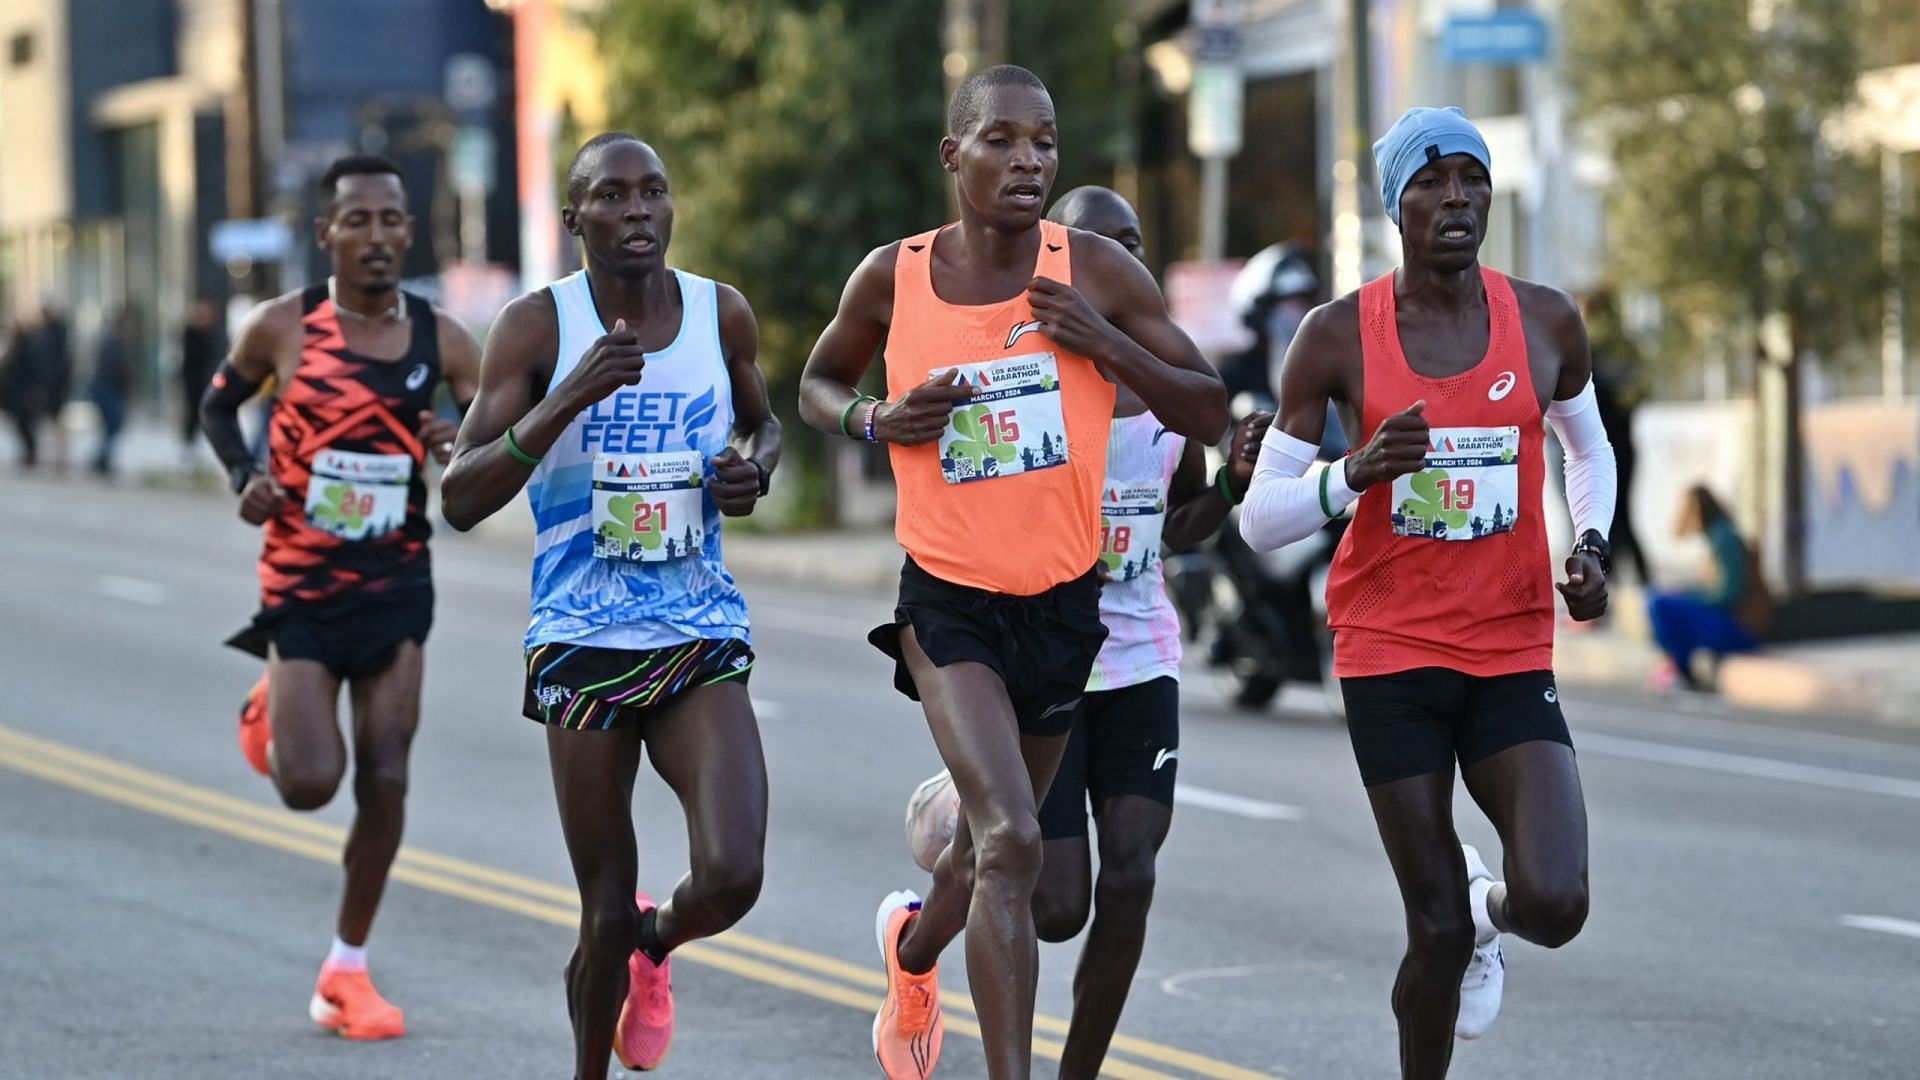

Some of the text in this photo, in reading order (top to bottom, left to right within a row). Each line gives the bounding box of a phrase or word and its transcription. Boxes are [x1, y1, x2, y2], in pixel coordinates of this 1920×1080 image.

[992, 369, 1041, 382] MARATHON
[1007, 363, 1039, 372] ANGELES
[579, 392, 687, 422] LEET
[970, 392, 994, 402] MARCH
[1005, 389, 1021, 398] 2024
[581, 423, 676, 453] FEET
[979, 410, 1020, 446] 15
[1457, 442, 1503, 450] MARATHON
[650, 466, 690, 474] MARATHON
[1436, 478, 1475, 511] 19
[633, 502, 668, 532] 21
[1101, 526, 1131, 553] 18
